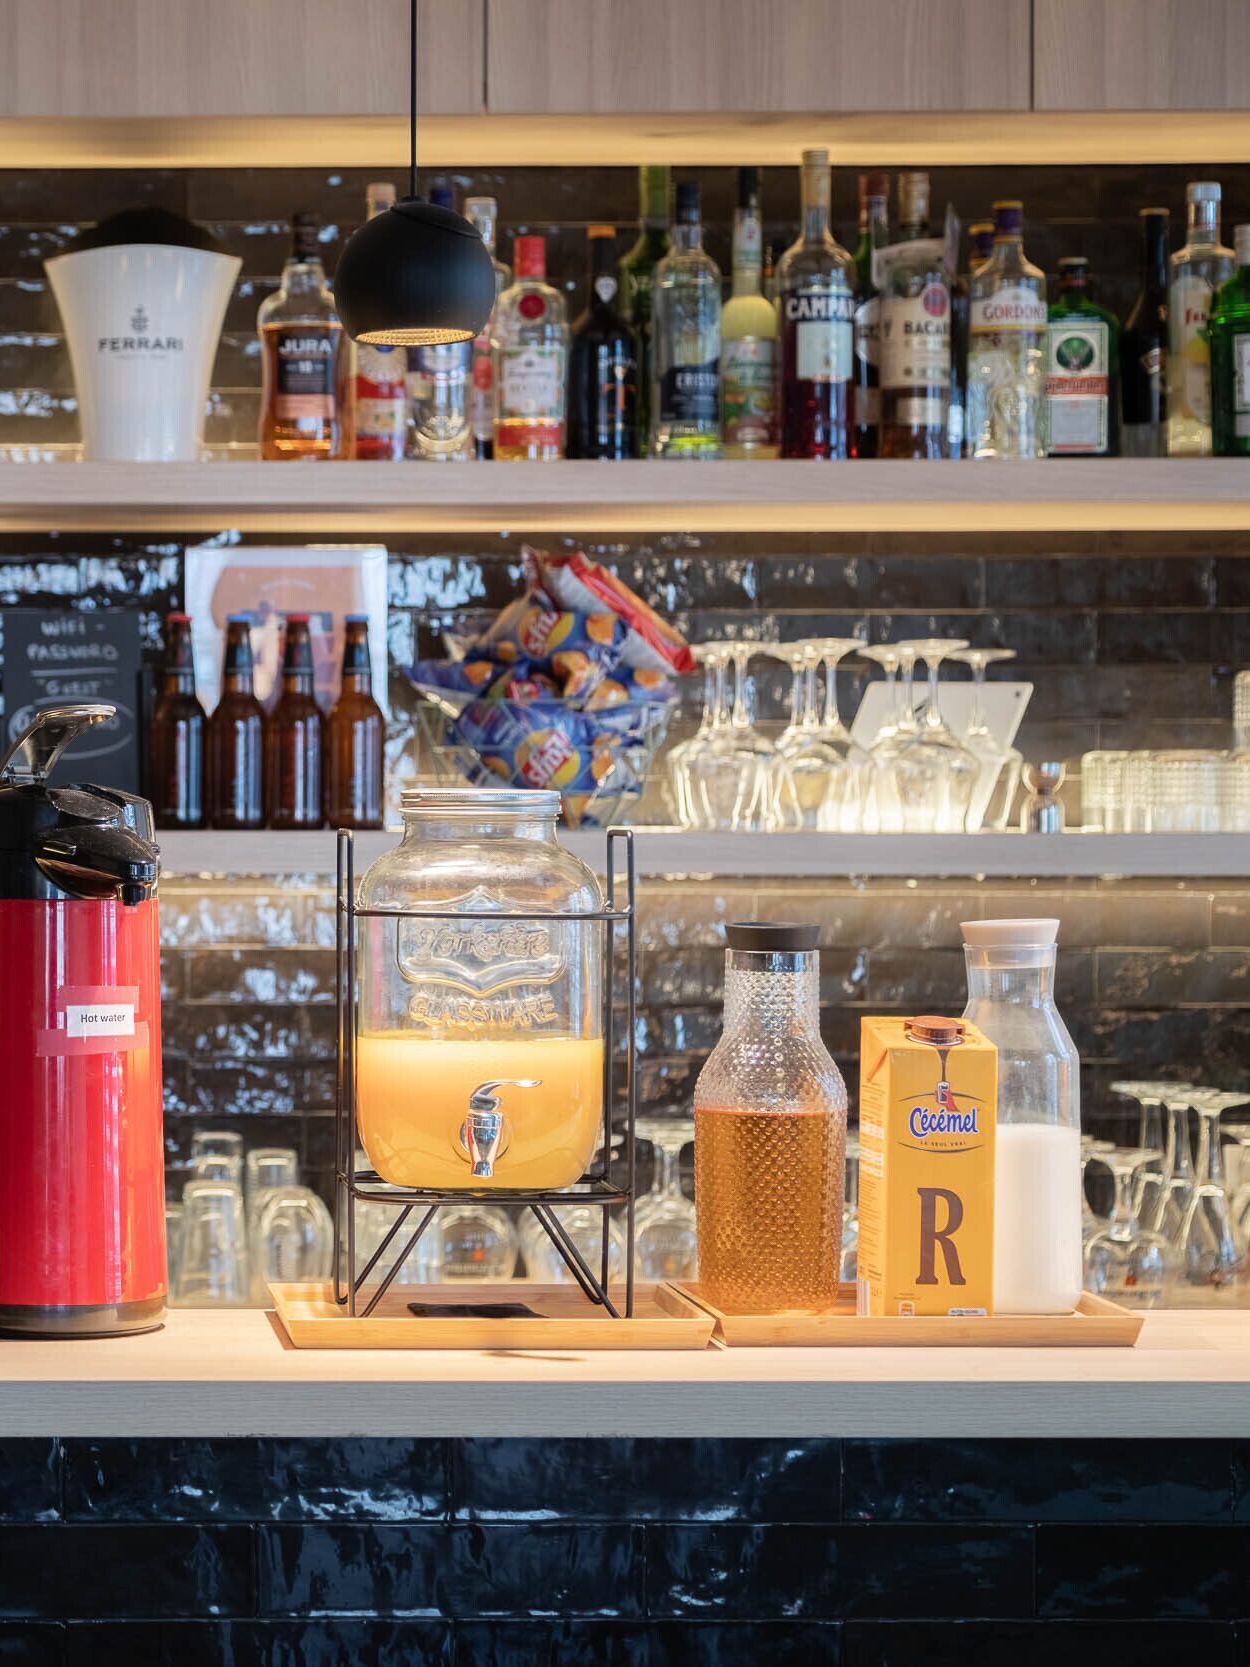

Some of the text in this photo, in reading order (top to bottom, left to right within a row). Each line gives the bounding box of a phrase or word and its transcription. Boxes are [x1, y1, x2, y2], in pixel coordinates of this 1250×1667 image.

[97, 337, 184, 352] FERRARI
[278, 338, 332, 352] JURA
[80, 1014, 126, 1023] Hot water
[909, 1106, 979, 1138] Cécémel
[915, 1187, 966, 1285] R
